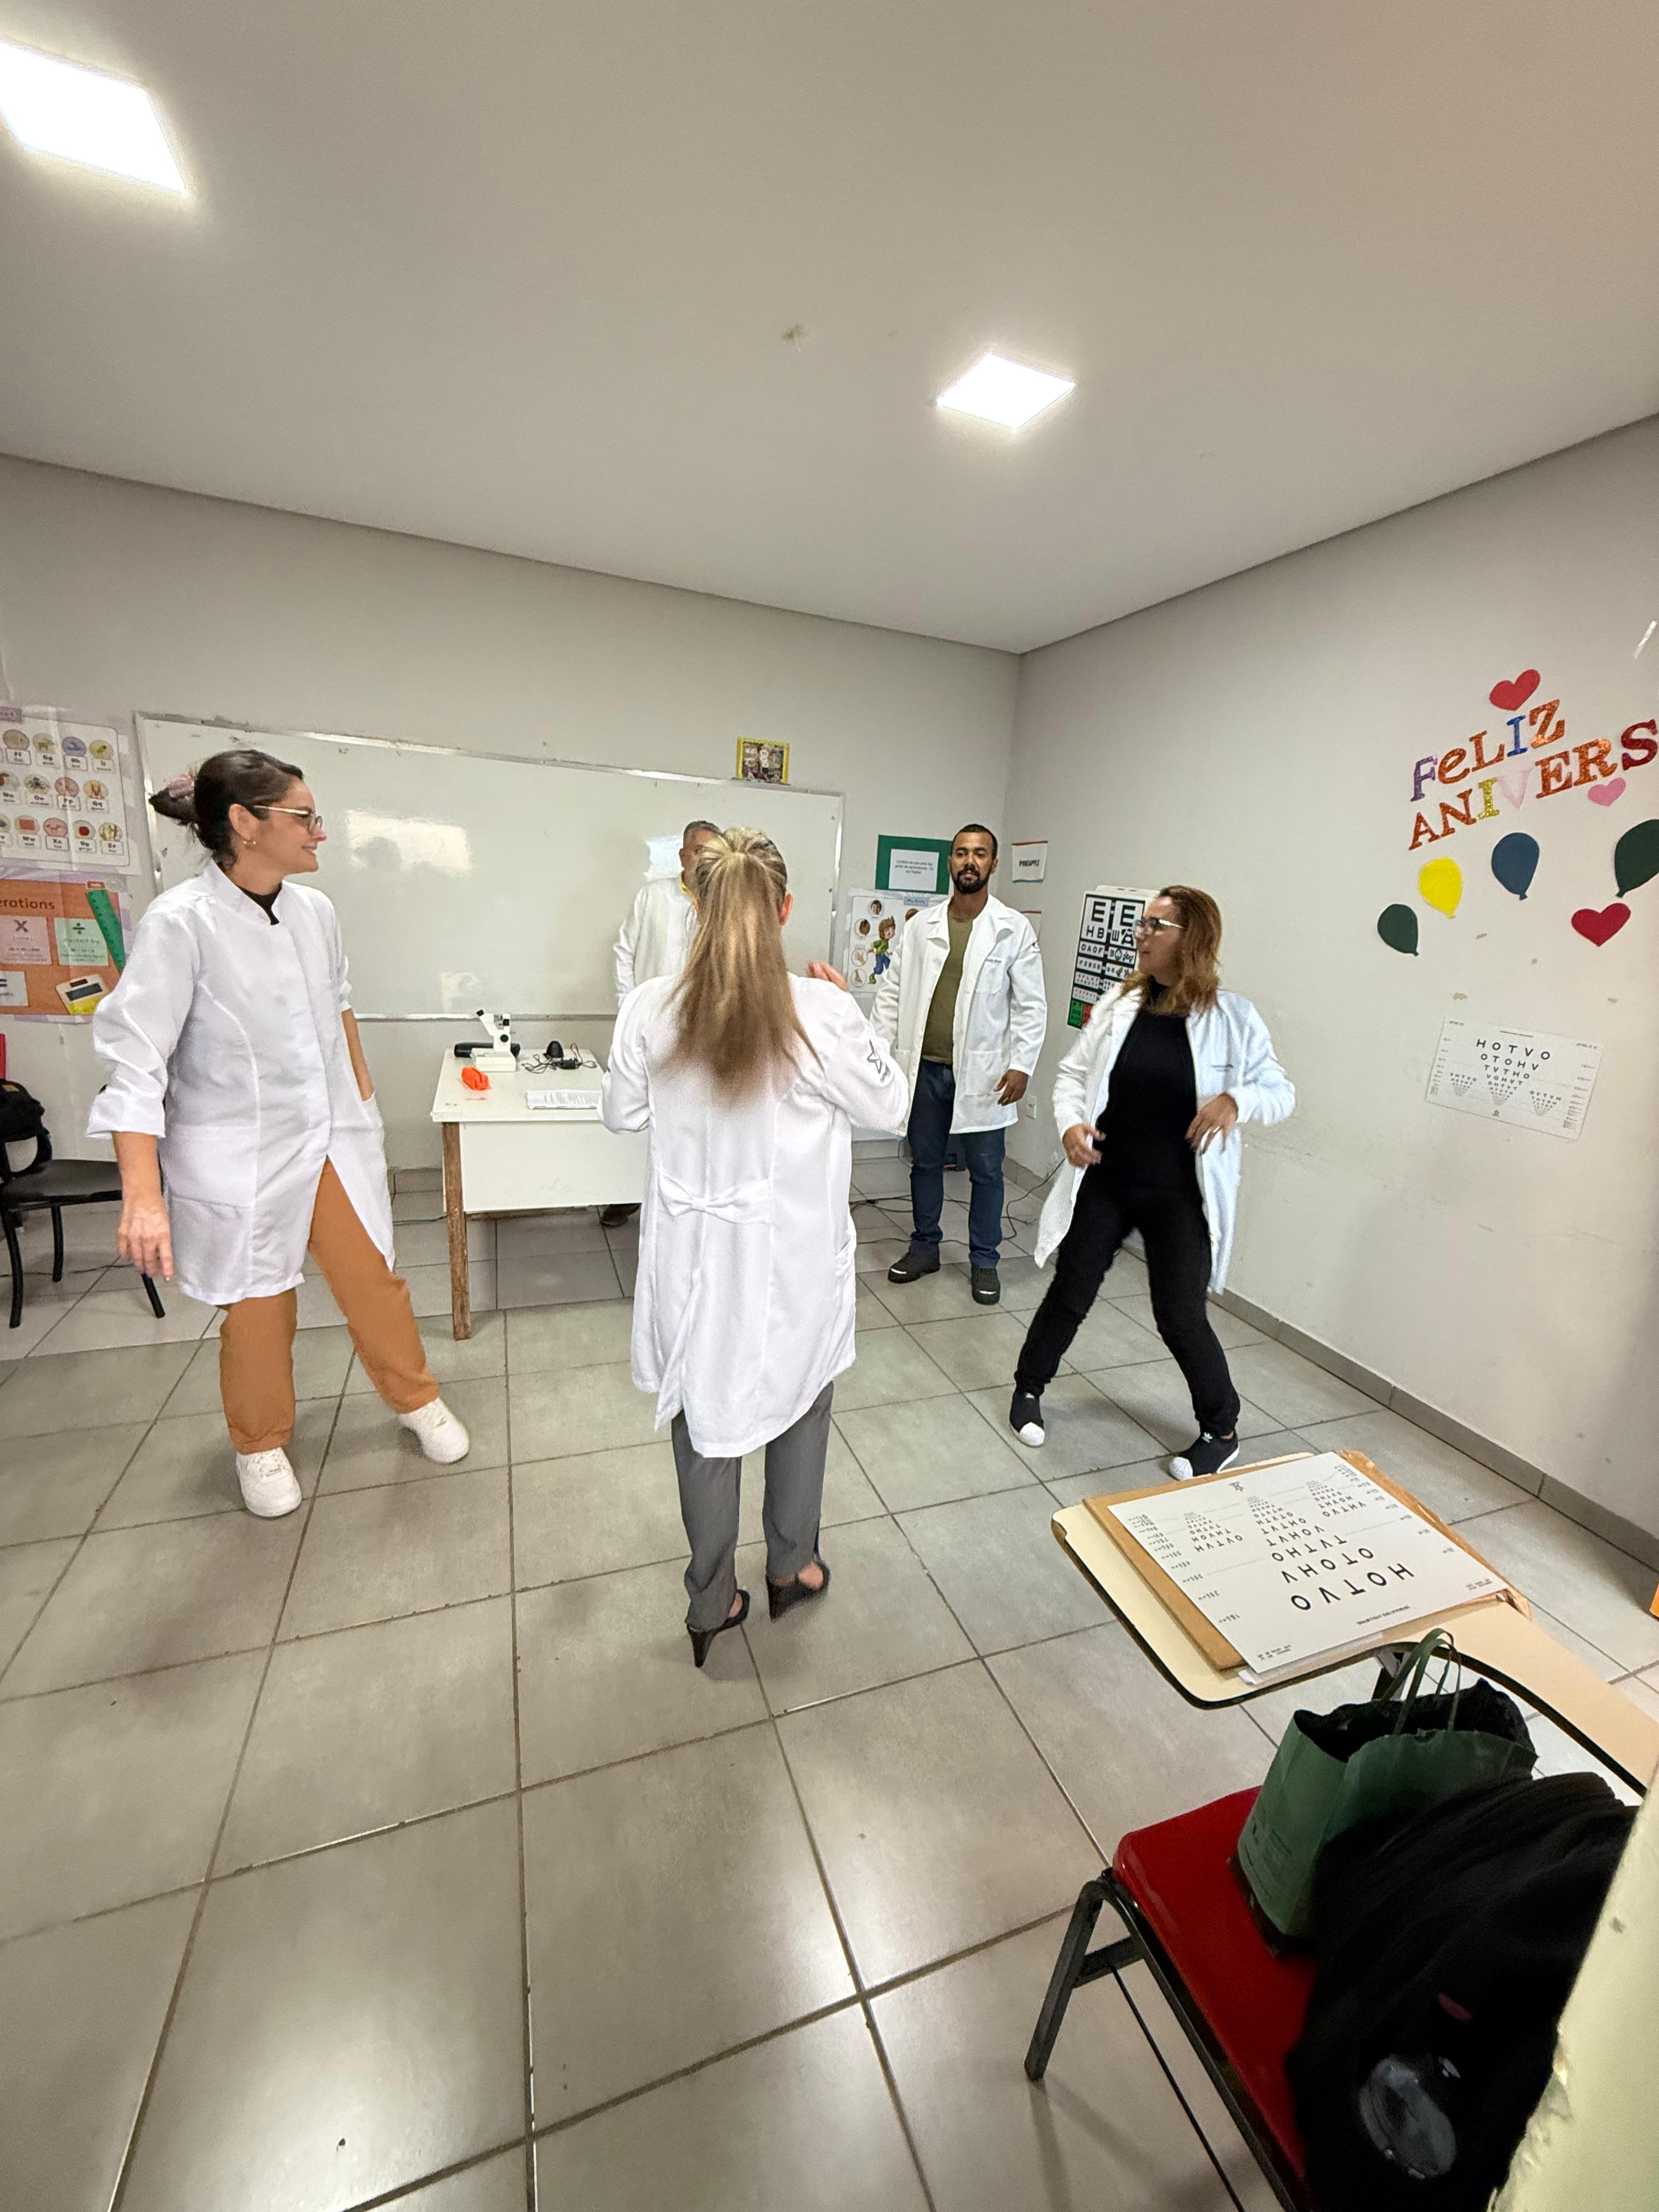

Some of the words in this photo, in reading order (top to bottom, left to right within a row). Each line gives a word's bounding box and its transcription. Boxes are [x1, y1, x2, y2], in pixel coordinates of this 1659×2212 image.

[0, 898, 55, 910] rations
[1091, 901, 1106, 923] E
[1120, 905, 1136, 927] E
